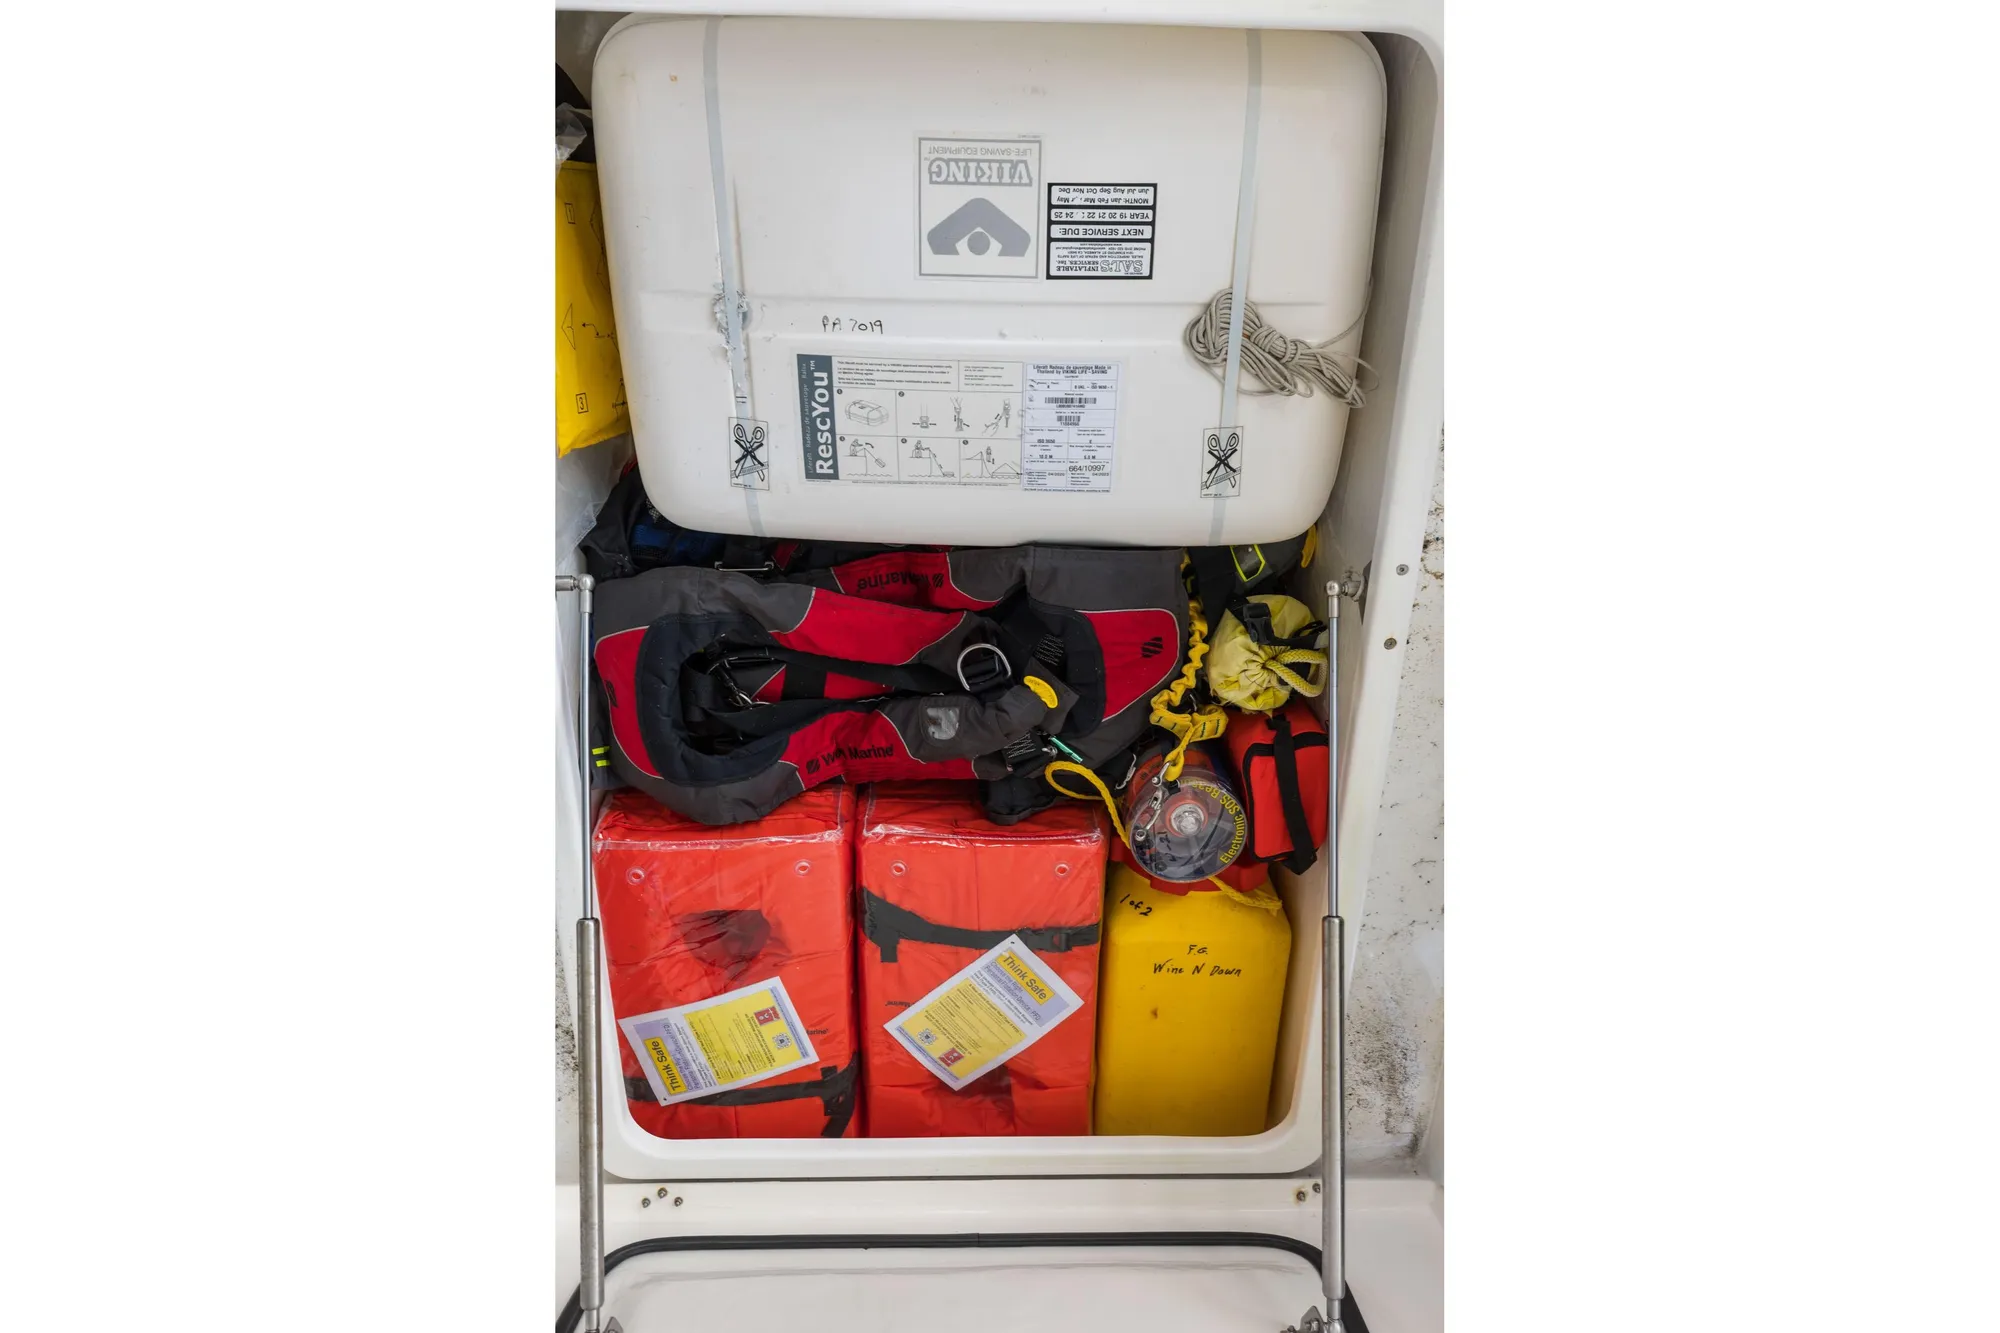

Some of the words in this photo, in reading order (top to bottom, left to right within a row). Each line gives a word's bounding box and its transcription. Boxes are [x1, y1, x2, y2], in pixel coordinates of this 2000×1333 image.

[928, 146, 978, 156] EQUIPMENT
[980, 147, 1033, 157] LIFE-SAVING
[929, 158, 1033, 187] VIKING
[1100, 260, 1143, 272] SAL'S
[849, 318, 883, 335] 7019
[579, 396, 584, 411] 3
[802, 383, 810, 416] sauvetage
[804, 416, 811, 425] de
[857, 571, 908, 590] Marine
[847, 745, 894, 761] Marine
[1219, 795, 1241, 815] SOS
[1220, 814, 1244, 864] Electronic
[1120, 893, 1130, 903] 1
[1129, 900, 1143, 910] of
[1139, 907, 1152, 916] 2
[989, 960, 1007, 977] Choose
[1004, 975, 1013, 983] the
[1009, 981, 1024, 994] Right
[1153, 958, 1184, 974] Wine
[1192, 963, 1205, 975] N
[1209, 965, 1242, 977] Down
[1002, 955, 1030, 980] Think
[1024, 977, 1050, 1000] Safe
[983, 965, 1003, 983] Personal
[999, 980, 1019, 998] Flotation
[1015, 995, 1031, 1011] Device
[648, 1040, 667, 1063] Safe
[660, 1063, 681, 1091] Think
[677, 1065, 685, 1073] the
[681, 1073, 694, 1090] Choose
